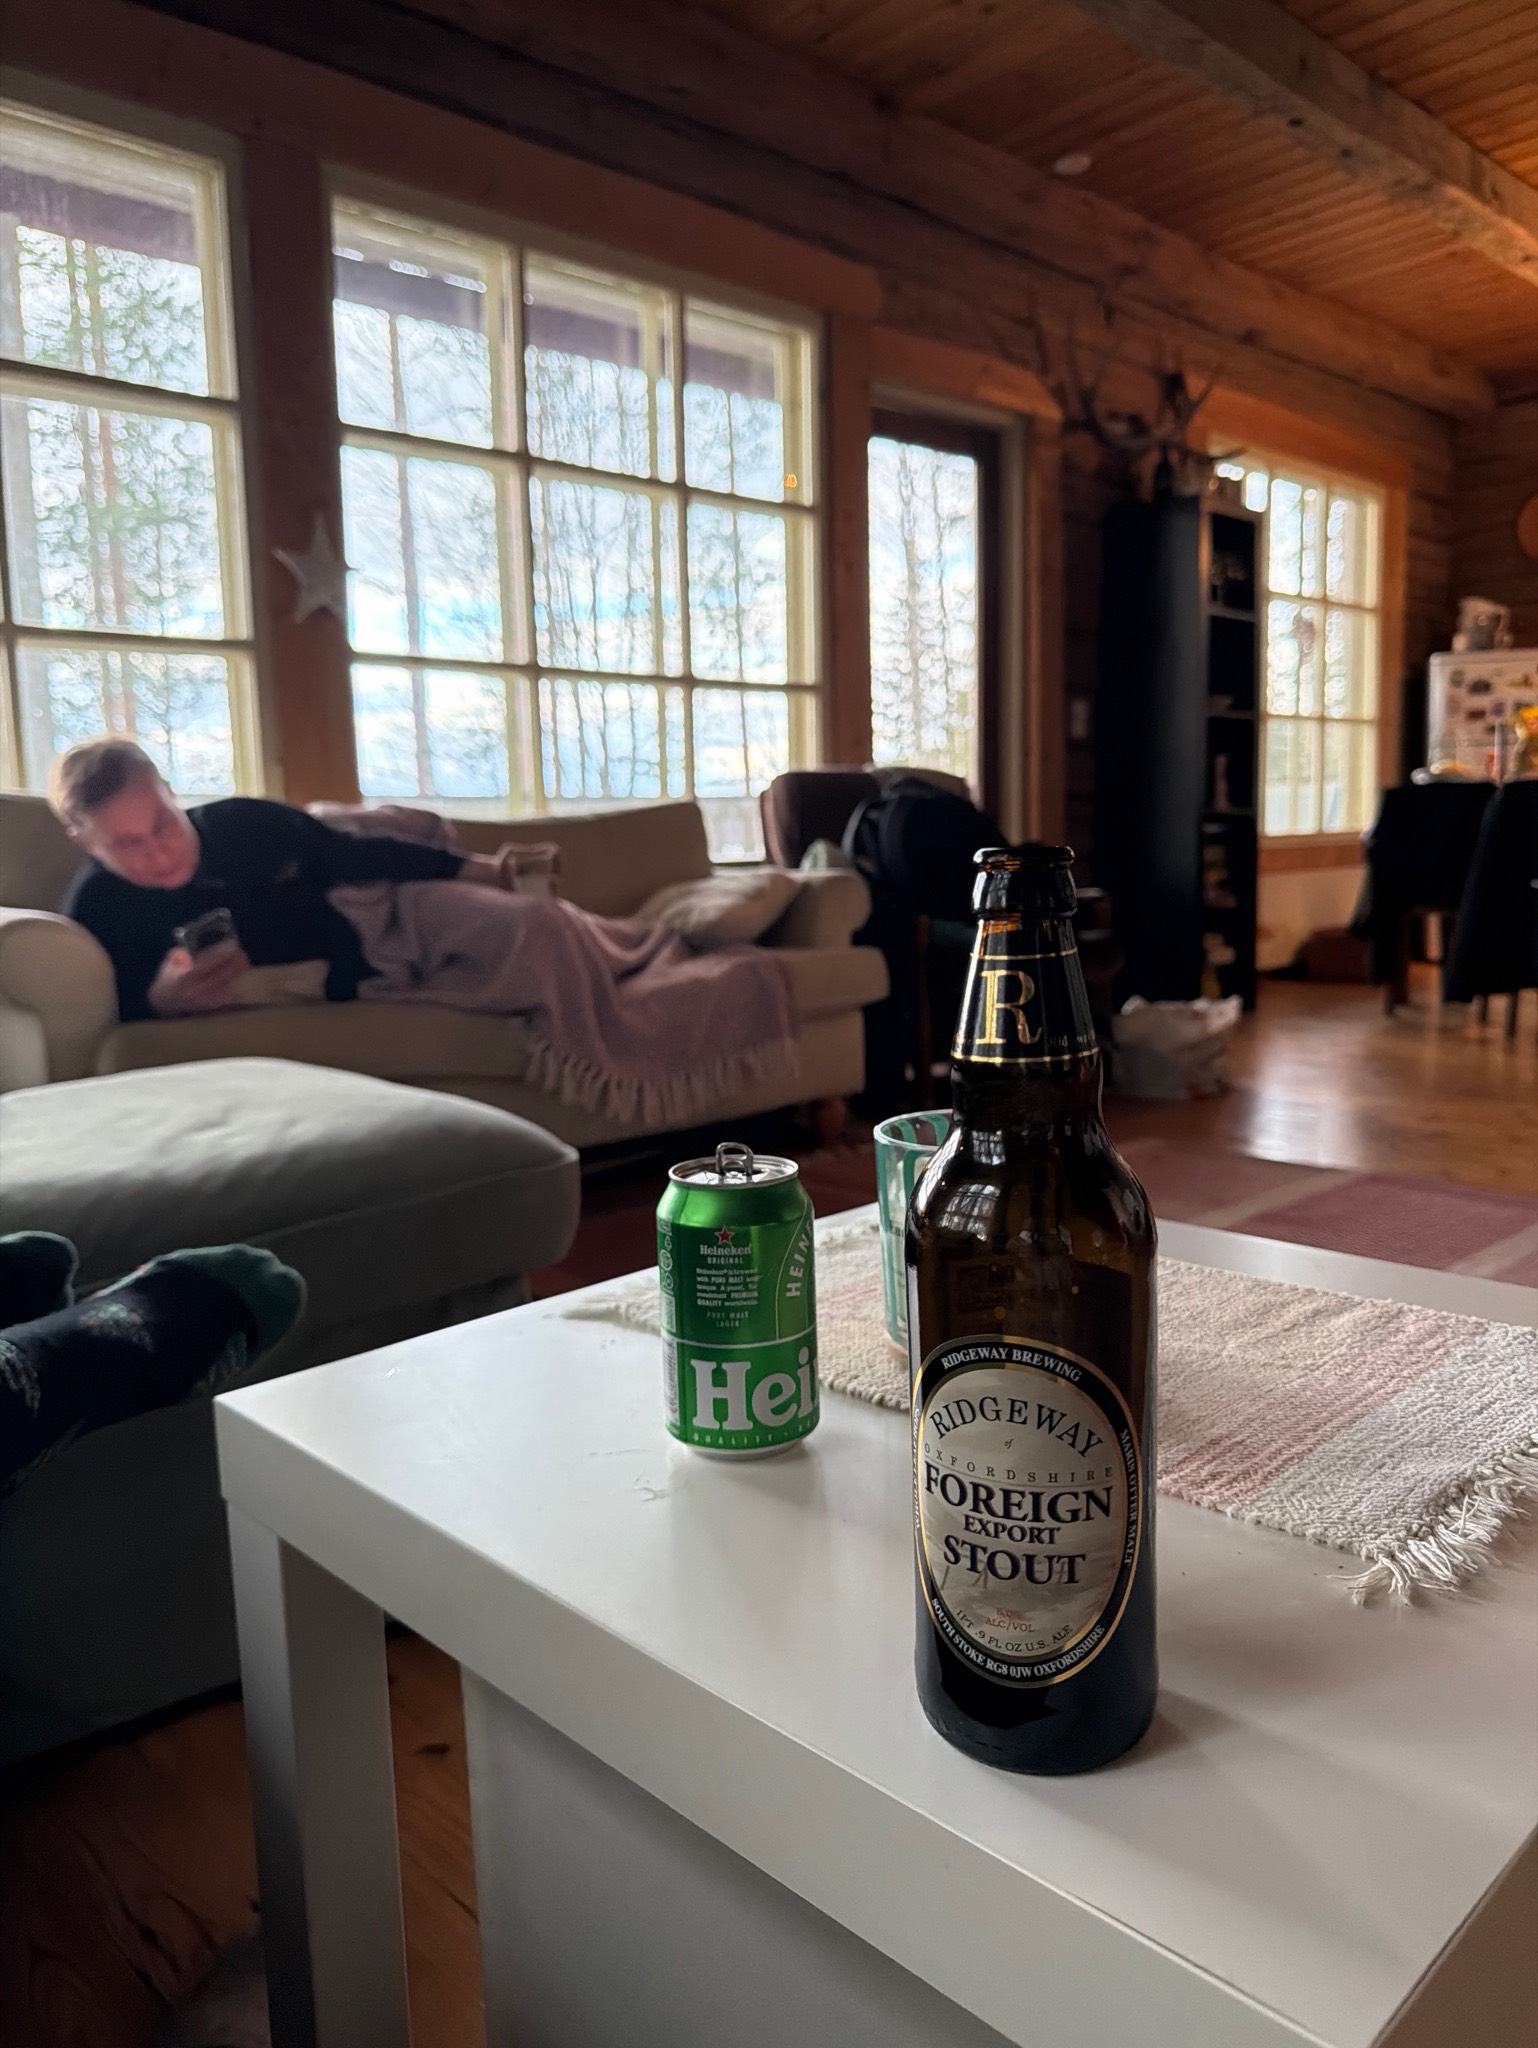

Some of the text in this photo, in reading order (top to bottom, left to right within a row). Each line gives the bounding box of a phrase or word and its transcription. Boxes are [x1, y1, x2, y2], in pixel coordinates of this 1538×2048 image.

[975, 970, 1042, 1045] R
[700, 1243, 752, 1256] Heineken
[707, 1256, 744, 1265] ORIGINAL
[941, 1347, 1082, 1382] RIDGEWAY BREWING
[690, 1346, 819, 1430] Hei
[929, 1396, 1104, 1457] RIDGEWAY
[1004, 1438, 1014, 1449] of
[924, 1443, 1113, 1483] OXFORDSHIRE
[1119, 1428, 1136, 1473] MARIS
[924, 1461, 1113, 1523] FOREIGN
[963, 1514, 1061, 1545] EXPORT
[943, 1535, 1086, 1585] STOUT
[930, 1597, 955, 1638] SOUTH
[952, 1632, 990, 1667] STOKE
[986, 1658, 1009, 1675] RG8
[1034, 1624, 1106, 1677] OXFORDSHIRE
[985, 1617, 1036, 1632] ALC/VOL
[987, 1635, 1002, 1648] FL
[1005, 1642, 1023, 1652] OZ
[1051, 1624, 1073, 1644] ALE
